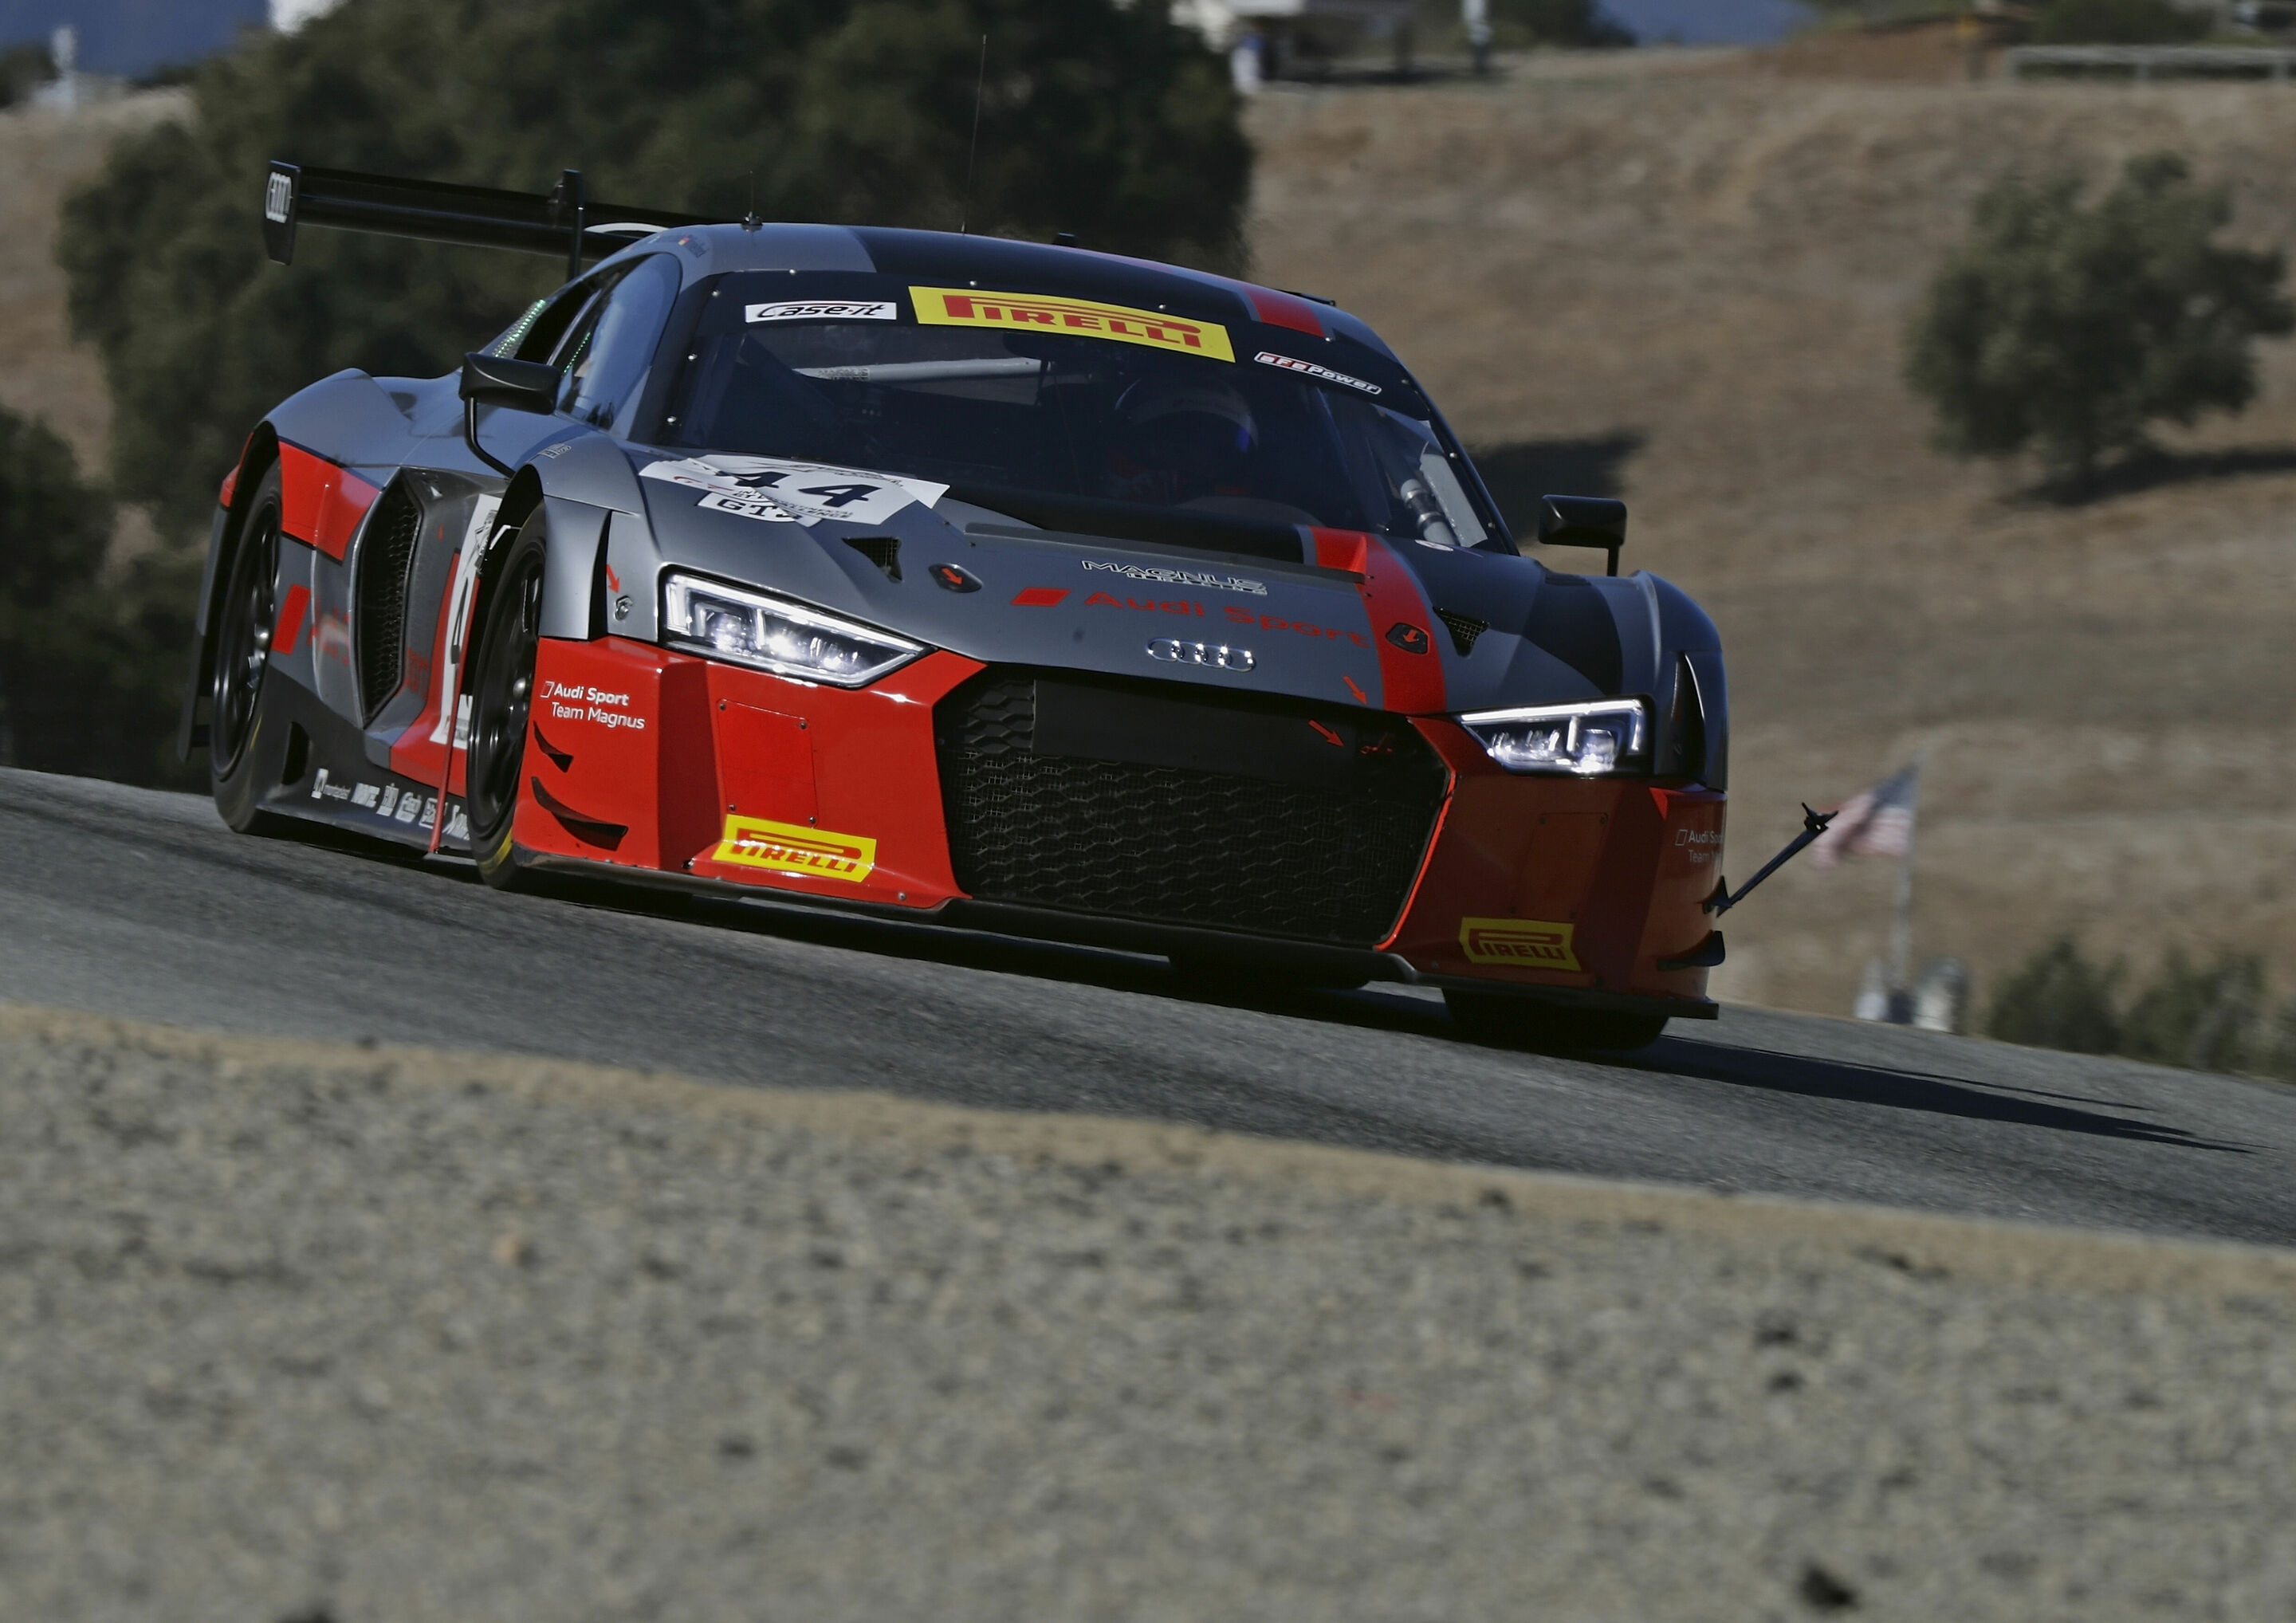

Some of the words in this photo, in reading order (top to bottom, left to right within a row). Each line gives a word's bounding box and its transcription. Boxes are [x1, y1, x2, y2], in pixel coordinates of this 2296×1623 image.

[943, 294, 1201, 348] PIRELLI
[1081, 560, 1267, 590] MAGNUS
[1083, 591, 1205, 617] Audi
[1224, 605, 1370, 649] Sport
[553, 682, 584, 699] Audi
[586, 686, 629, 706] Sport
[551, 701, 584, 719] Team
[588, 706, 647, 729] Magnus
[729, 827, 862, 873] PIRELLI
[1689, 830, 1708, 843] Audi
[1468, 928, 1567, 961] PIRELLI
